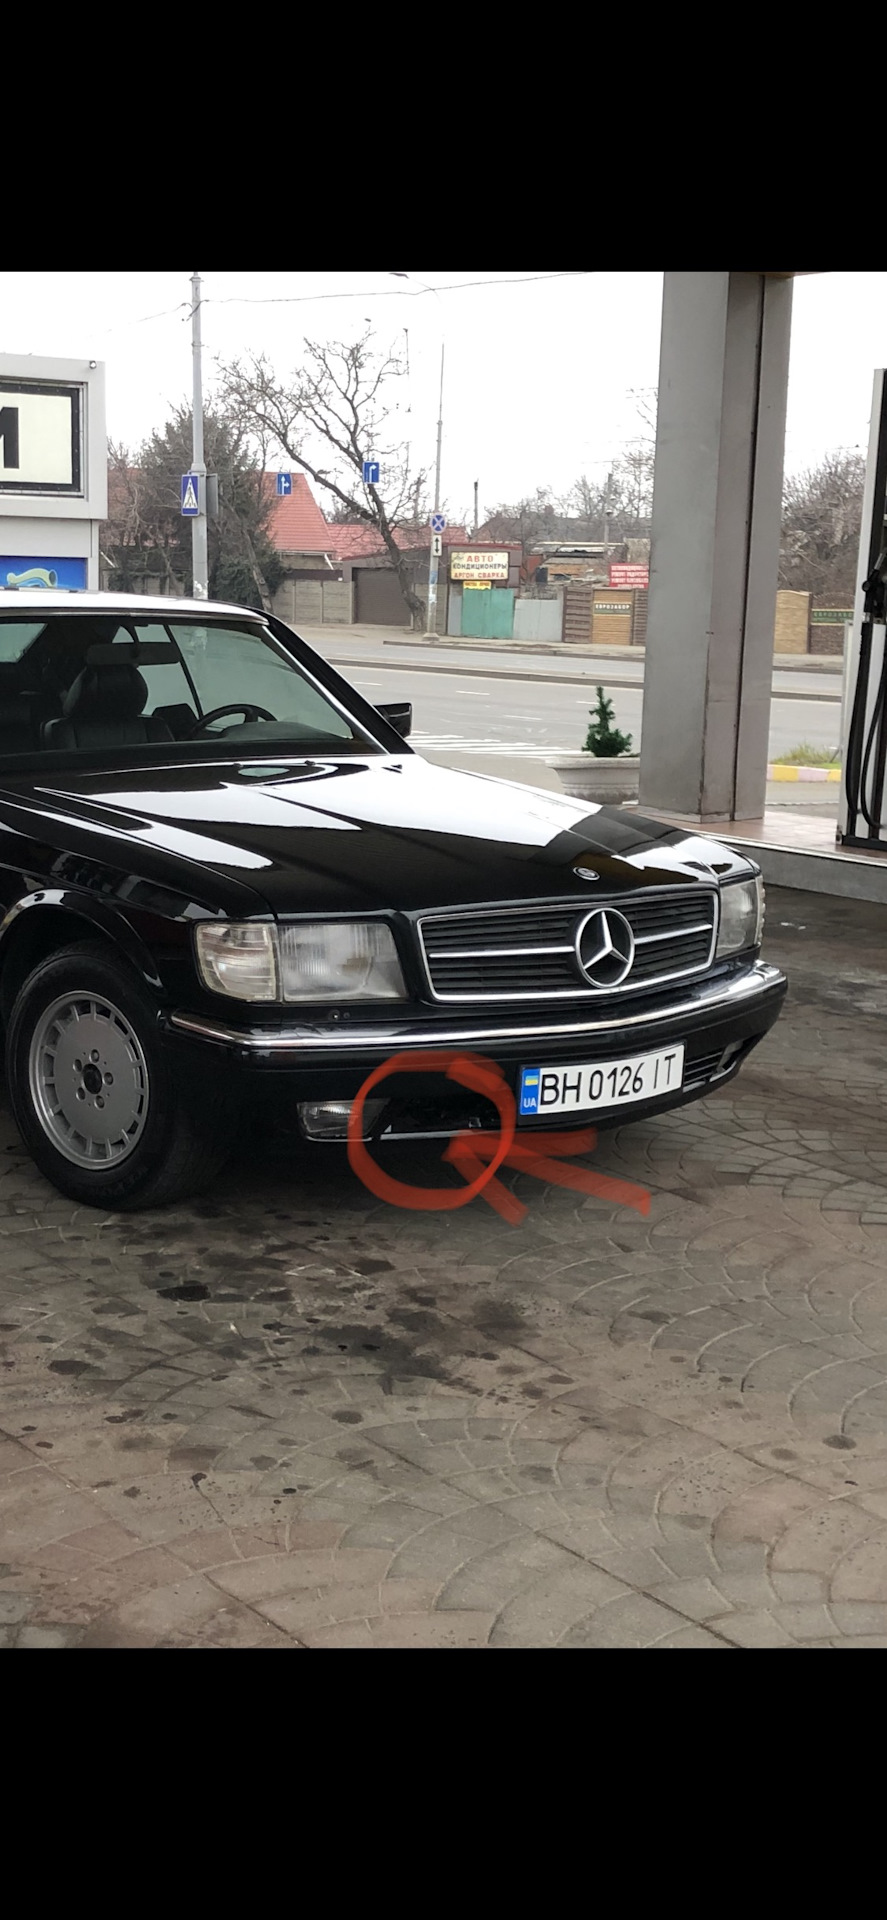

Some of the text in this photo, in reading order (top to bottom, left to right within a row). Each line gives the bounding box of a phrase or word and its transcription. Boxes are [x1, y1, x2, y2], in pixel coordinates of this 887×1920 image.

[540, 1054, 676, 1106] BH 0126 IT
[523, 1098, 537, 1108] UA
